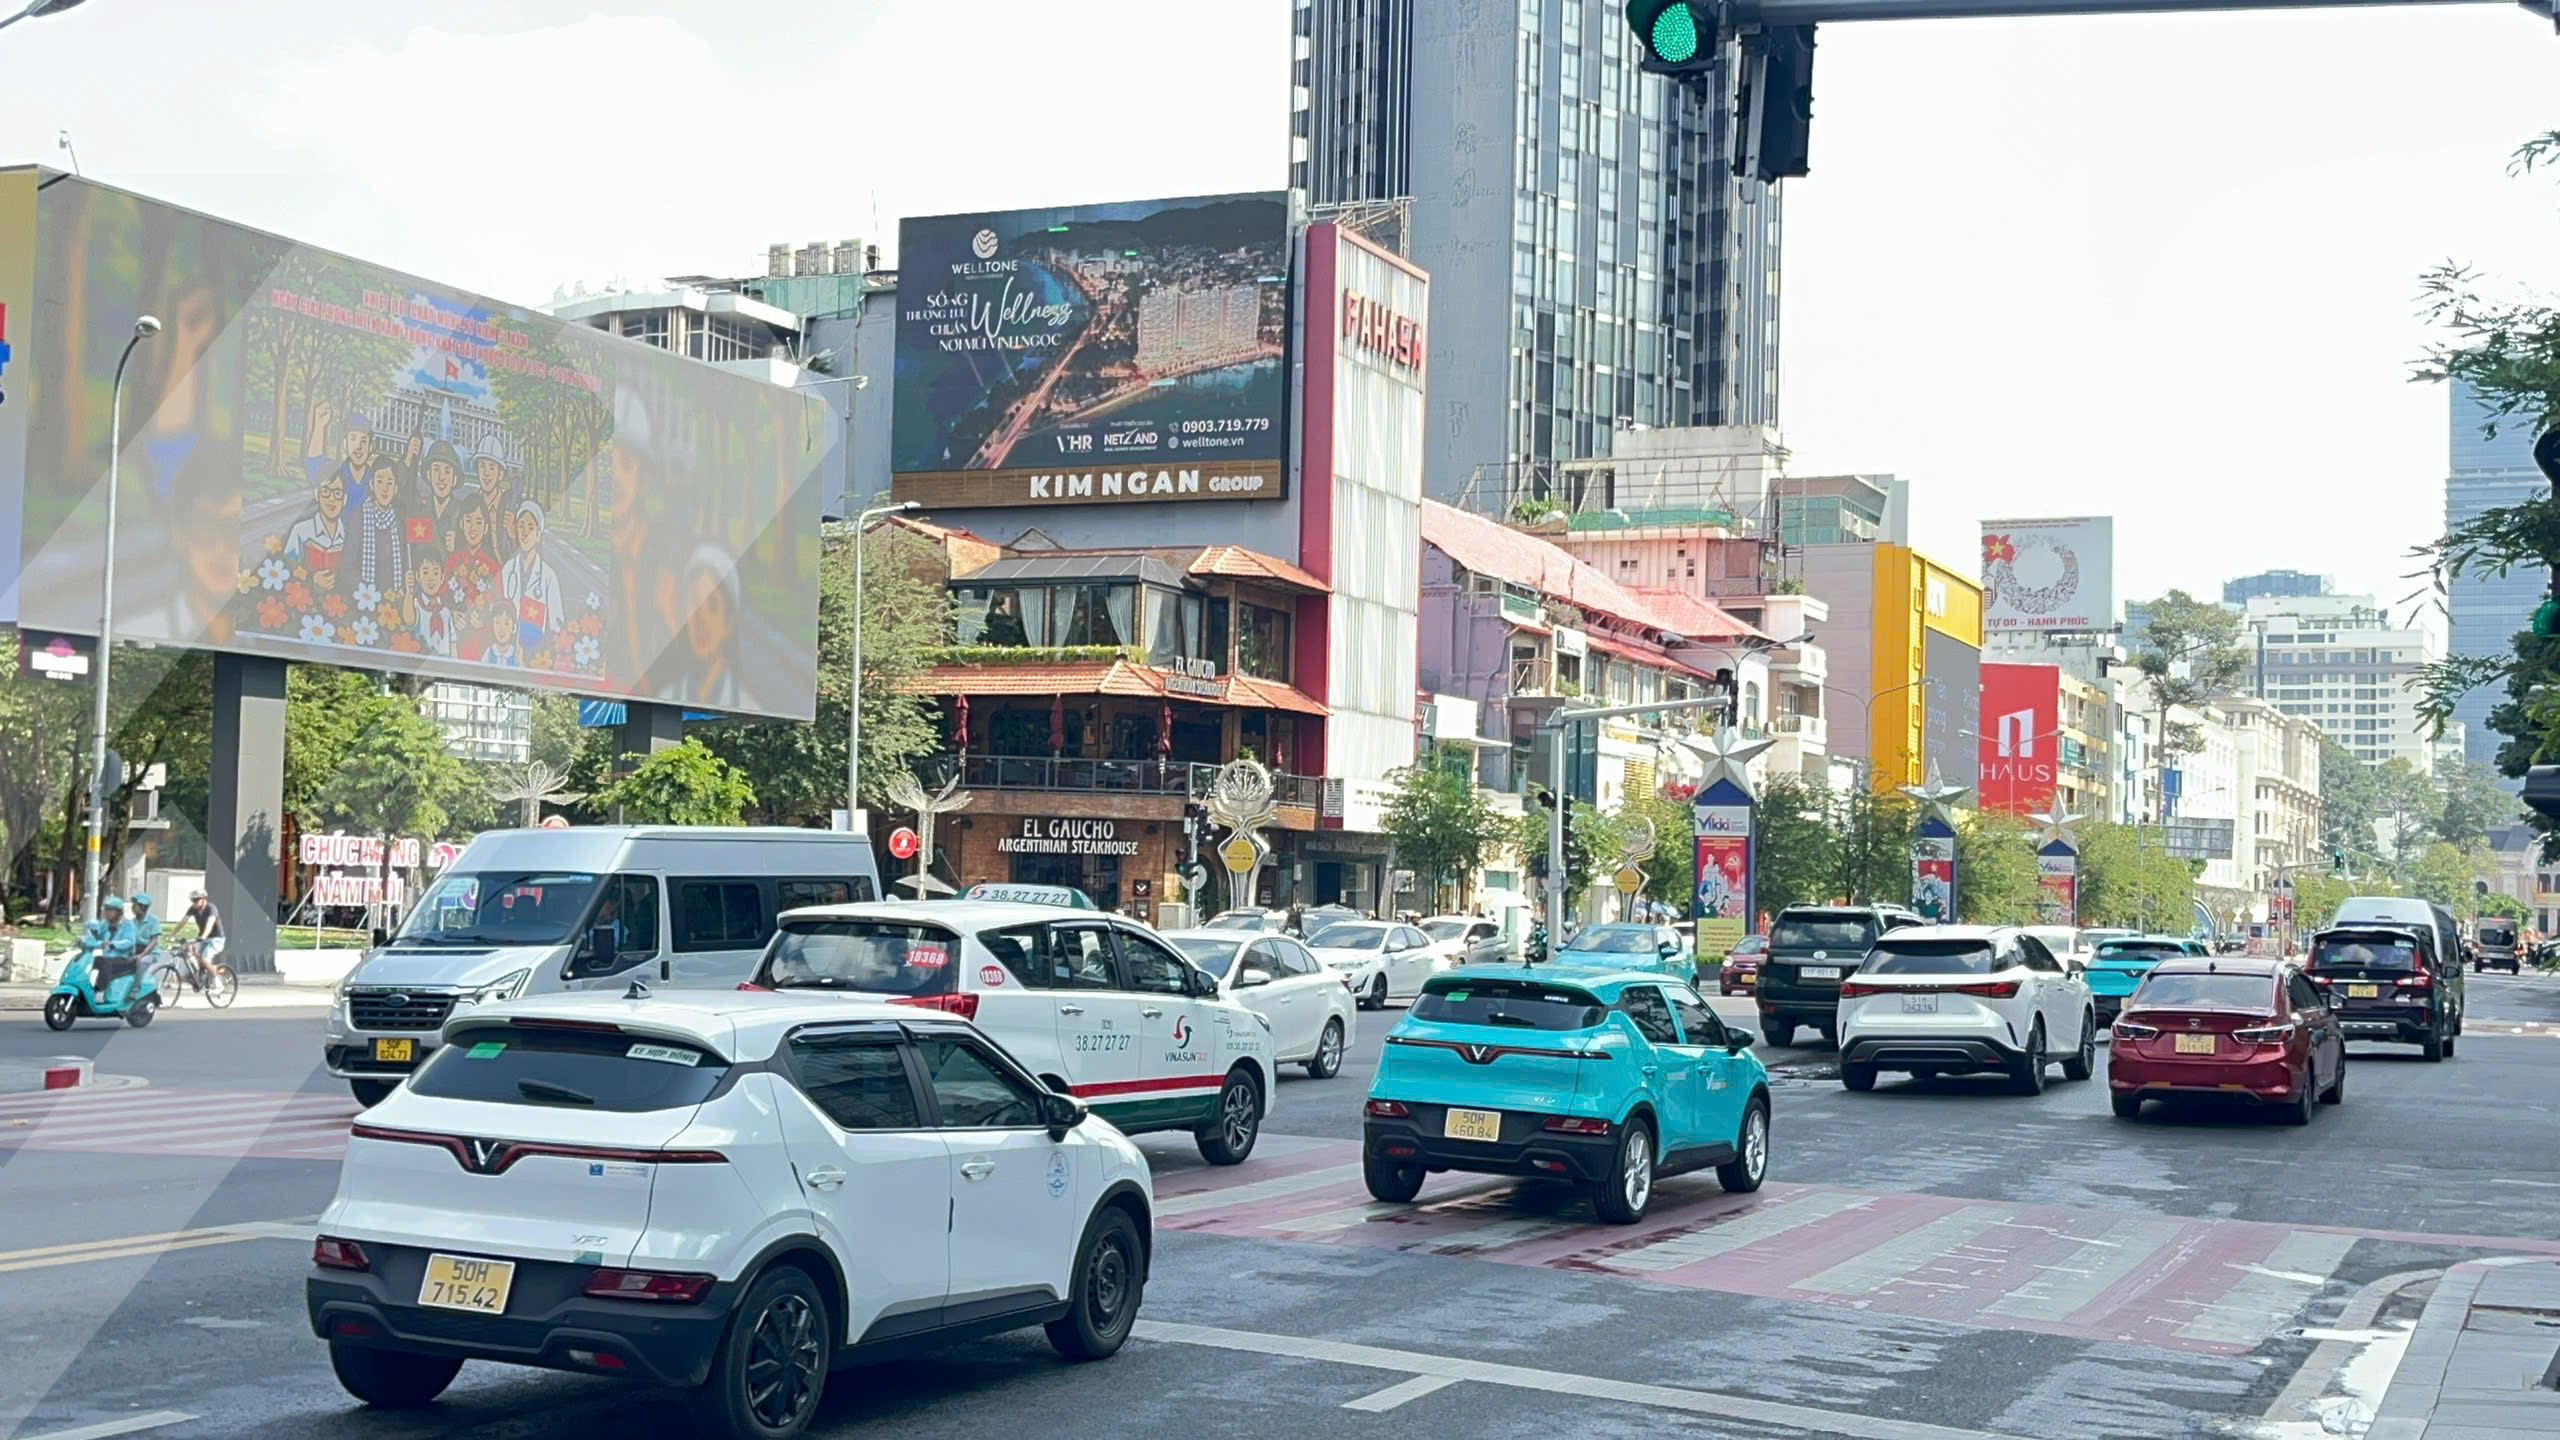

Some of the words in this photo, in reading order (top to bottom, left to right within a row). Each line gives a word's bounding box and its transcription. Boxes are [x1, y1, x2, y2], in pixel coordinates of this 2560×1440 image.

[951, 259, 1018, 275] WELLTONE
[970, 276, 1073, 339] Wellness
[1343, 287, 1422, 370] FAHASA
[1182, 418, 1269, 434] 0903.719.779
[1182, 436, 1244, 449] welltone.vn
[1030, 473, 1093, 498] KIM
[1101, 470, 1199, 496] NGAN
[1209, 475, 1264, 492] GROUP
[1023, 818, 1042, 838] EL
[1048, 819, 1114, 839] GAUCHO
[998, 838, 1067, 854] ARGENTINIAN
[1071, 840, 1138, 856] STEAKHOUSE
[1104, 1034, 1117, 1050] 27
[1118, 1034, 1131, 1050] 27
[1463, 1112, 1486, 1125] 50H
[1453, 1124, 1492, 1138] 460.84
[451, 1260, 489, 1283] 50H
[432, 1281, 499, 1309] 715.42
